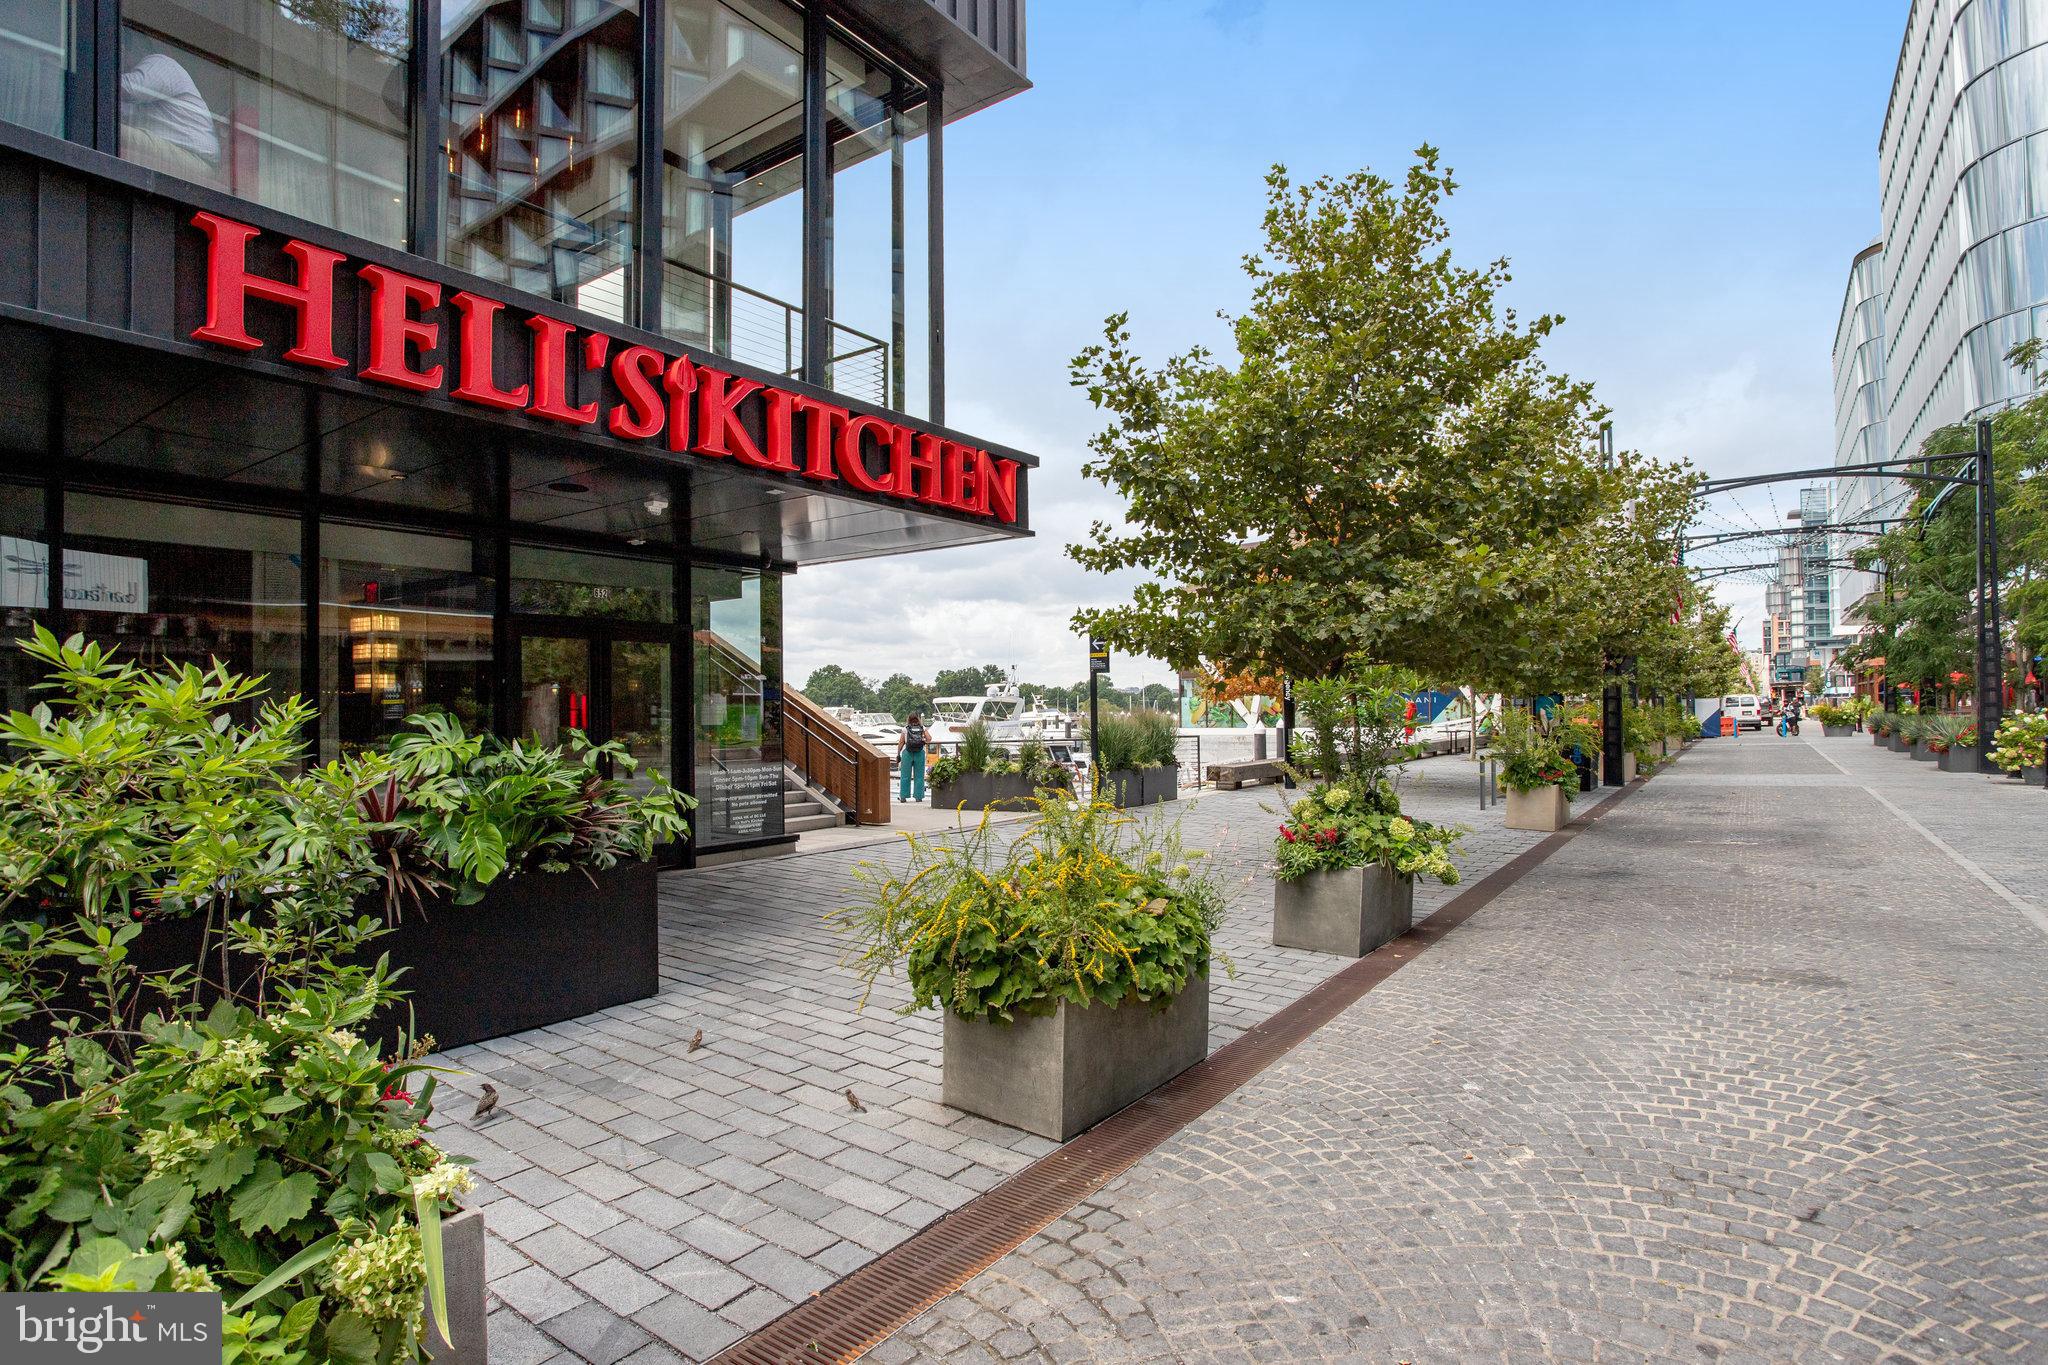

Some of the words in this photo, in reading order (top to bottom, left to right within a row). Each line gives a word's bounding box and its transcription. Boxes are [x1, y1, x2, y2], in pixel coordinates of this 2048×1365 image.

[190, 211, 665, 440] HELL'S
[691, 366, 1020, 523] KITCHEN
[594, 588, 607, 598] 652
